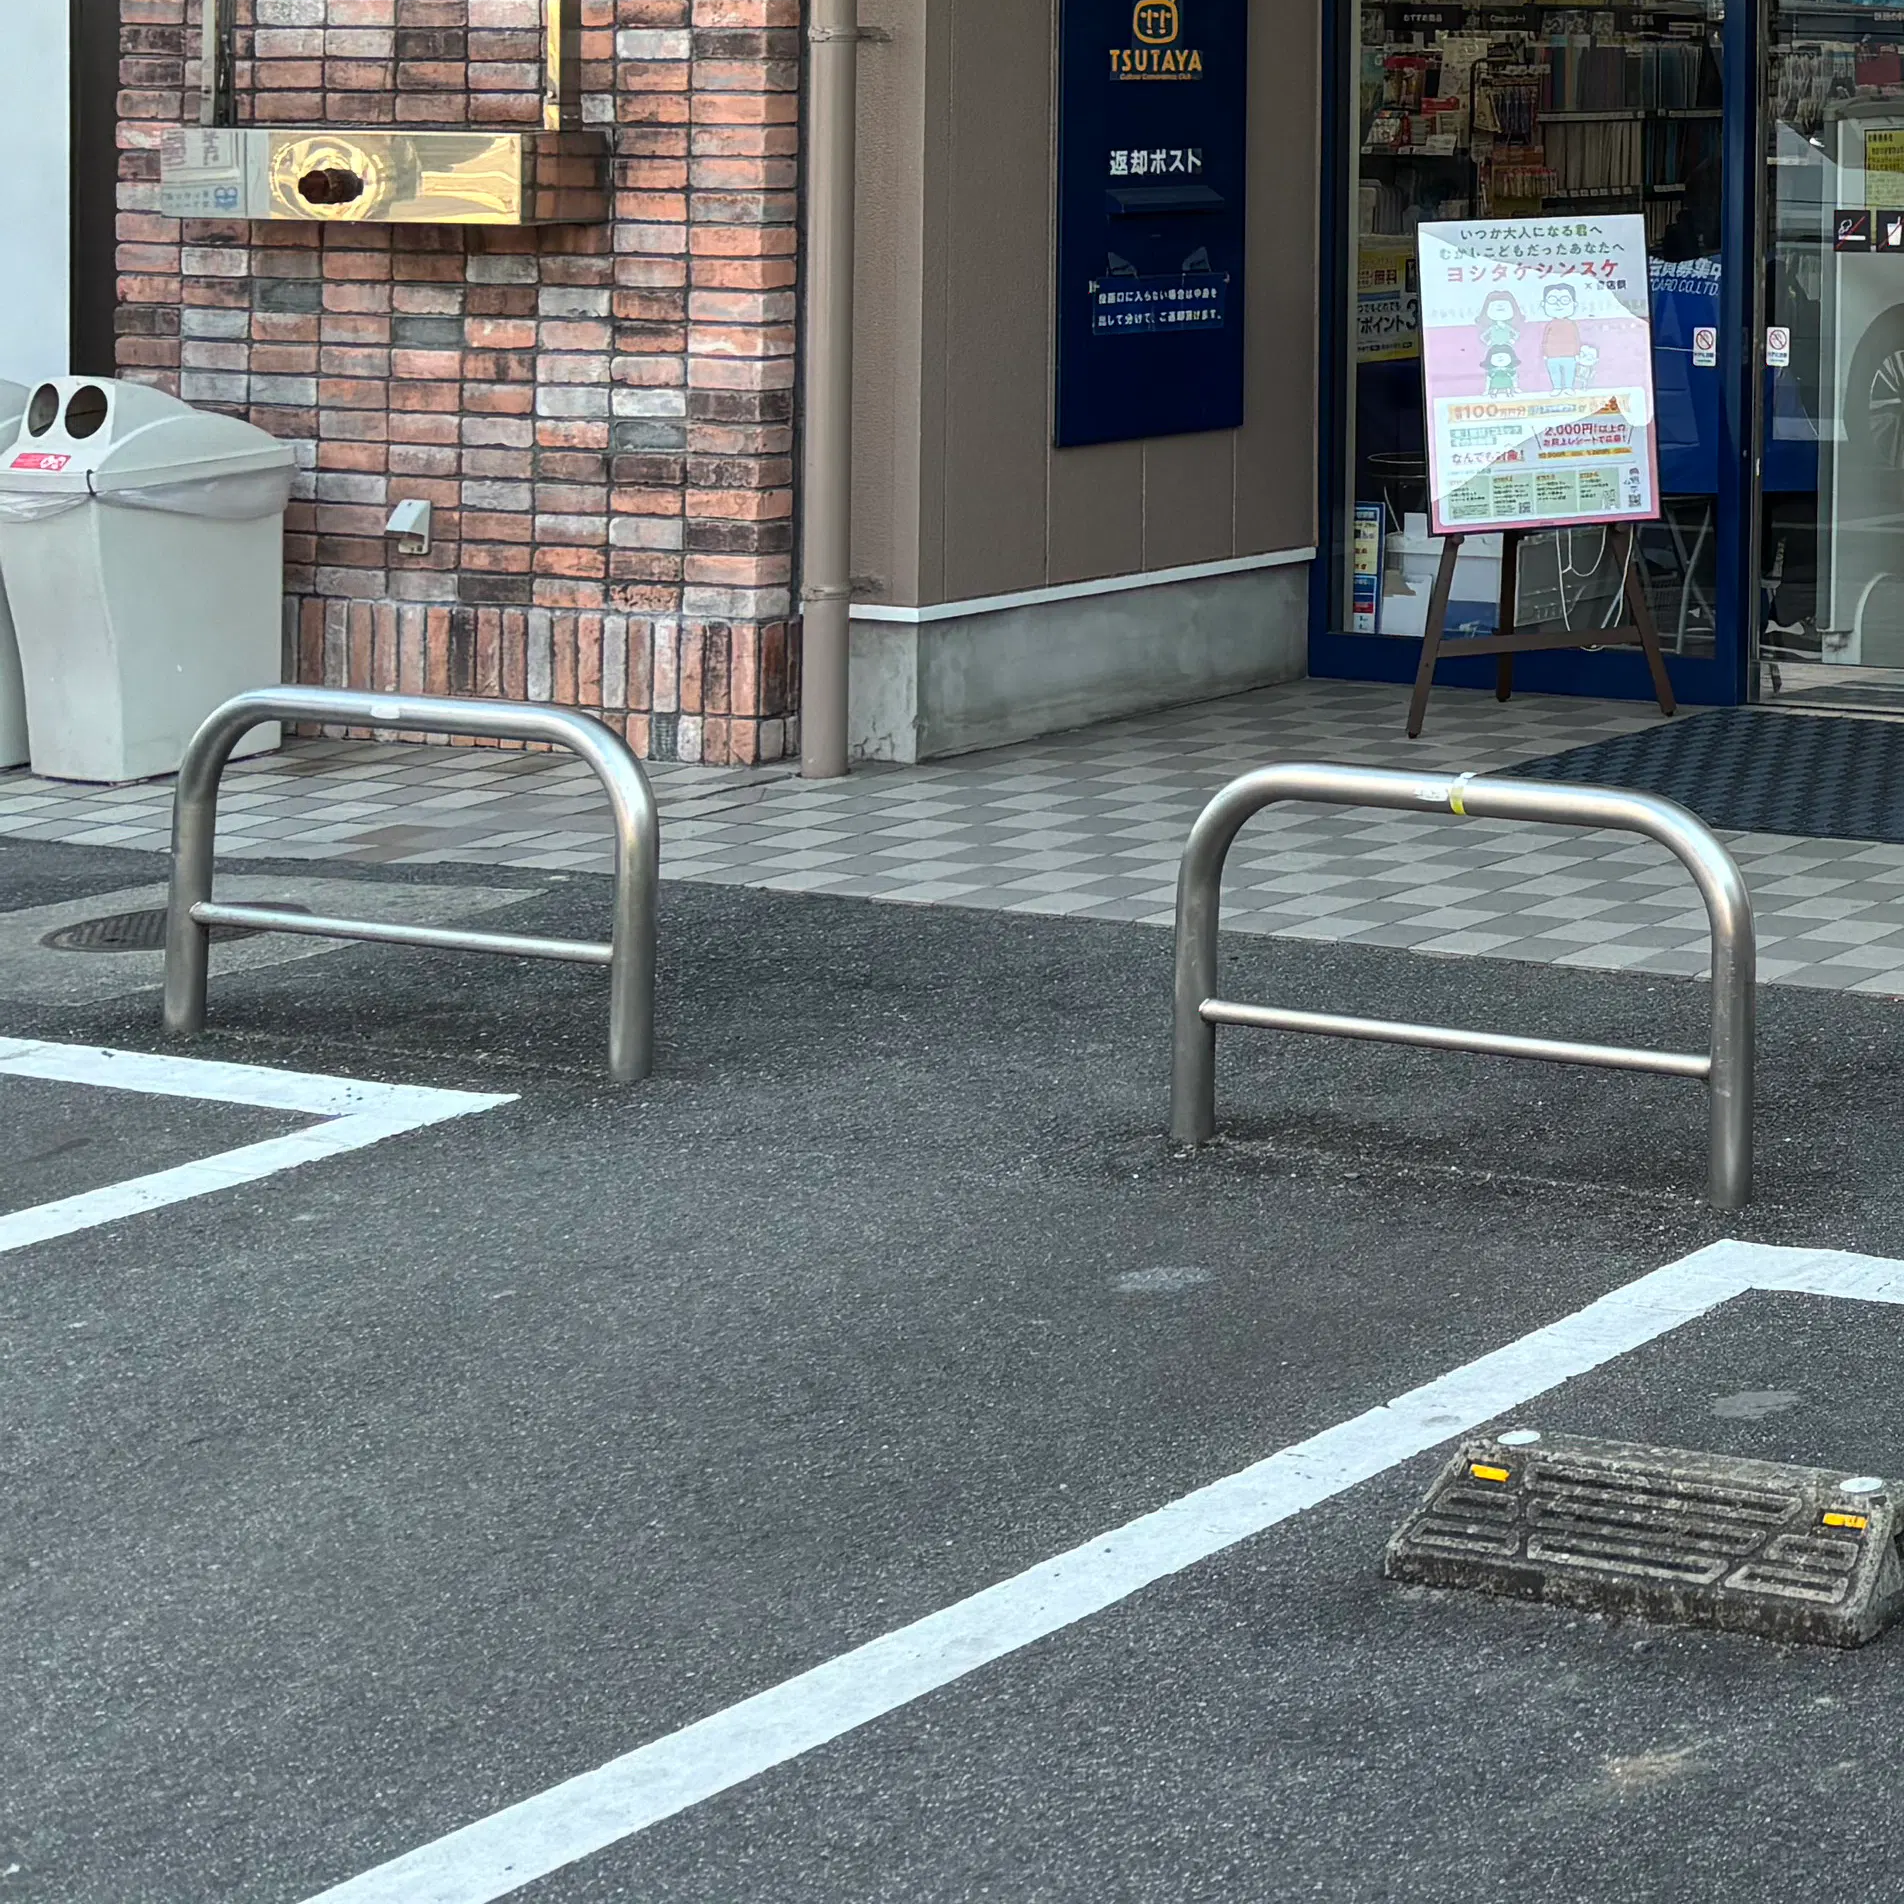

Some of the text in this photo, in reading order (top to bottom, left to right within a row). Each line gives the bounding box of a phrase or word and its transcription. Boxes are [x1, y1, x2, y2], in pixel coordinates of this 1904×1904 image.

[1108, 49, 1203, 72] TSUTAYA
[1108, 147, 1203, 176] 返却ポスト
[1460, 223, 1603, 241] いつか大人になる君へ
[1447, 259, 1619, 282] ヨシタケシンスケ
